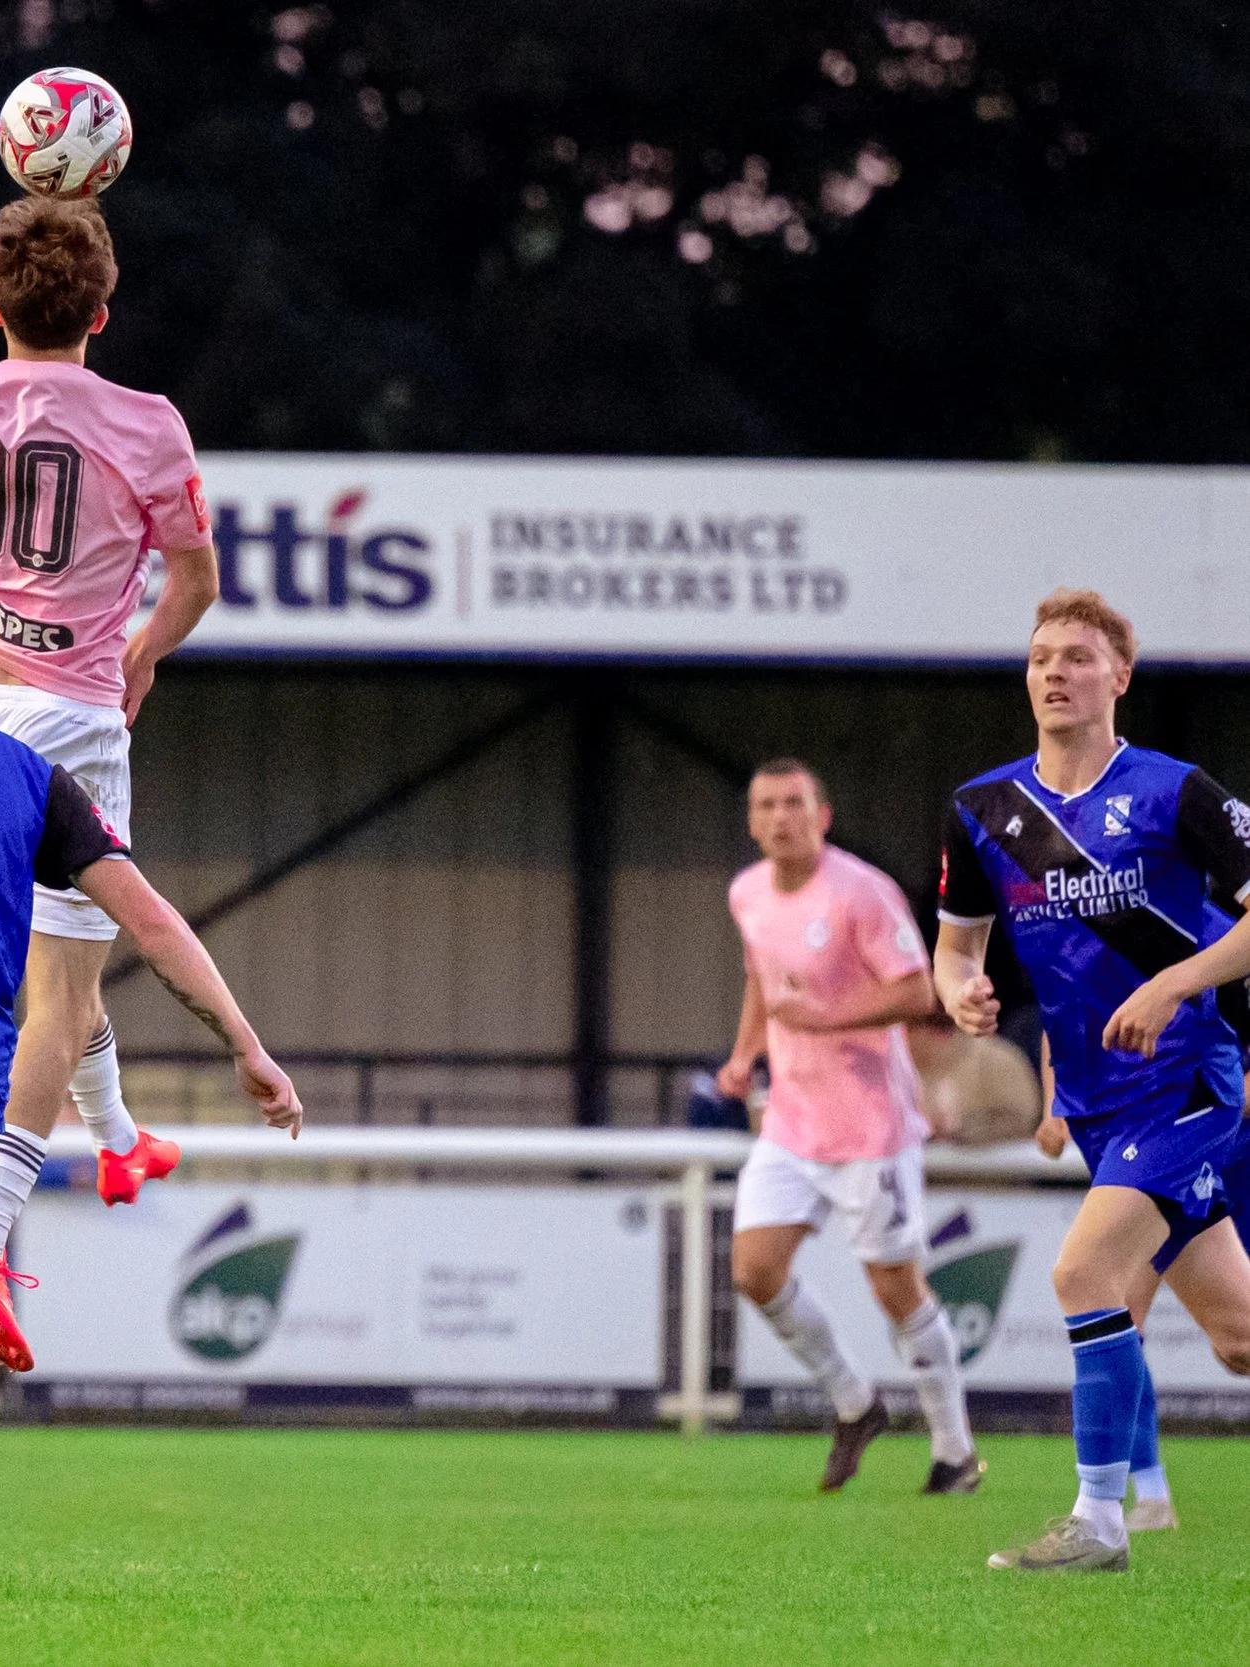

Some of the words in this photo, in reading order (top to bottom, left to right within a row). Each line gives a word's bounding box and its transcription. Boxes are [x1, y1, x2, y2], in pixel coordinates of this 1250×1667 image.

[211, 486, 433, 611] ttis
[490, 513, 803, 560] INSURANCE
[490, 564, 736, 609] BROKERS
[749, 568, 848, 613] LTD
[1045, 857, 1145, 902] Electrical
